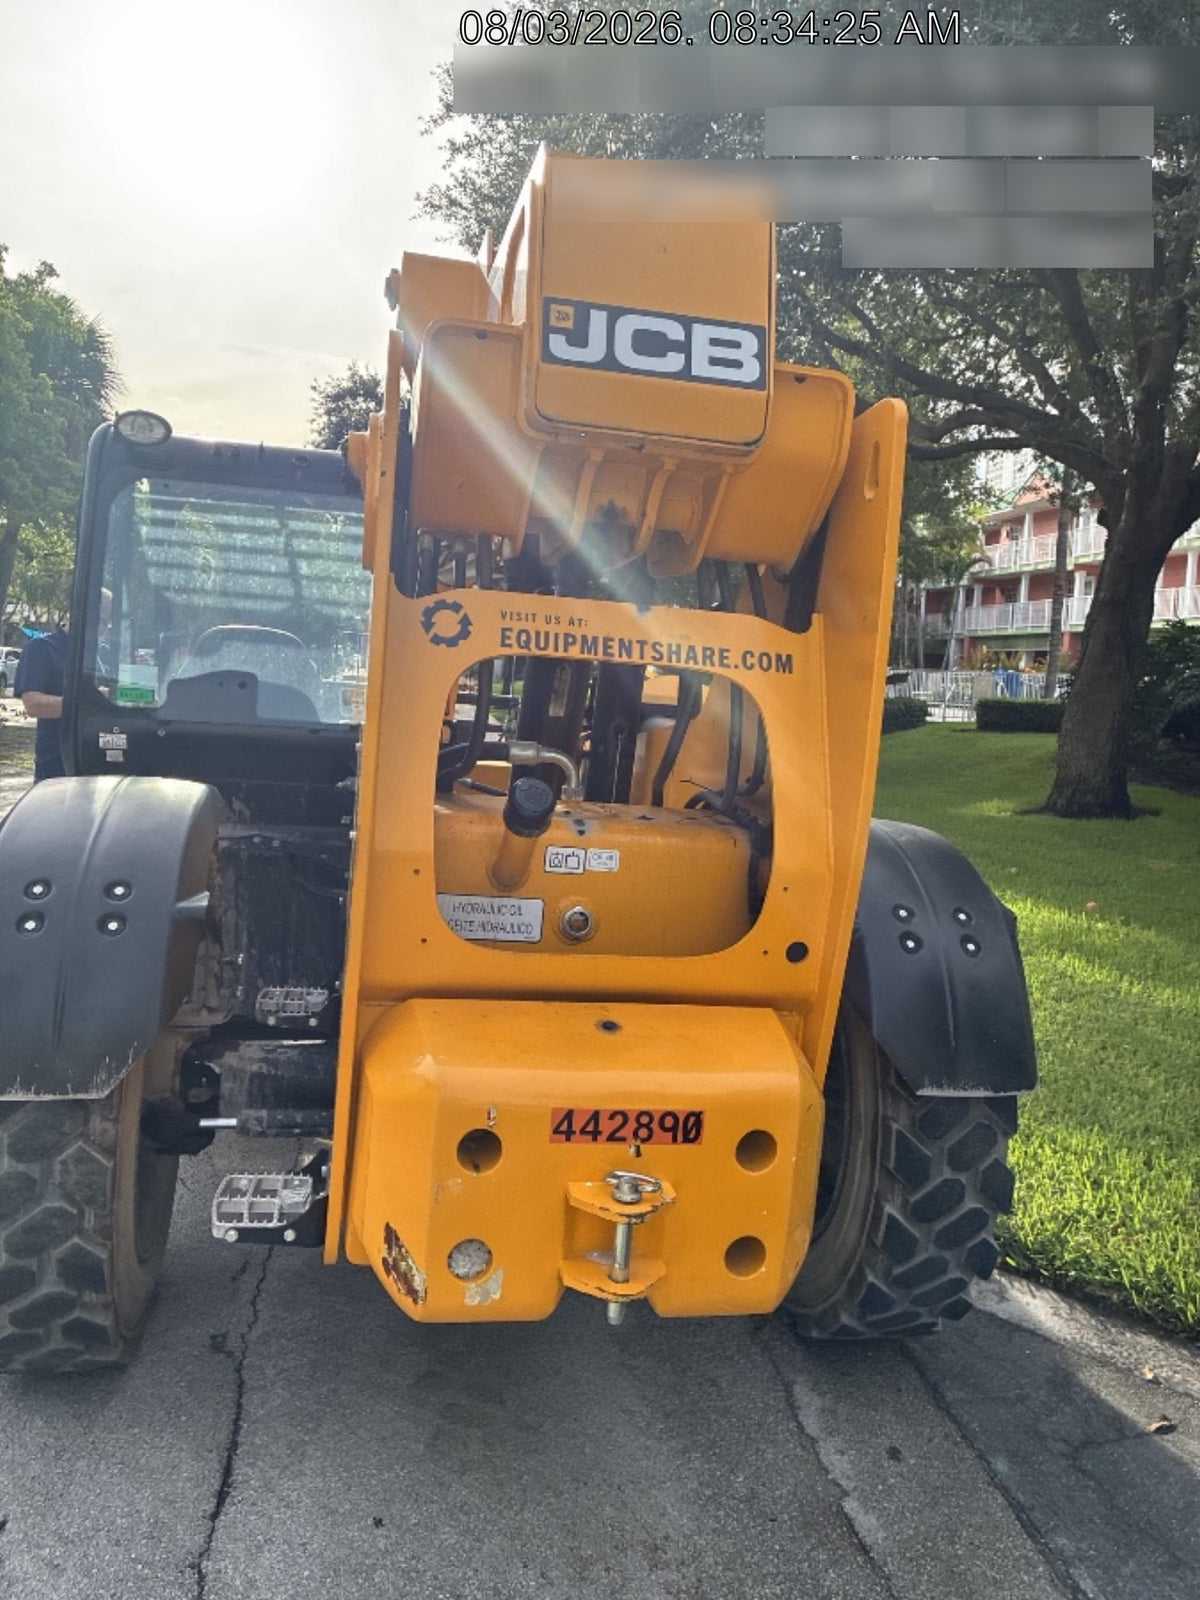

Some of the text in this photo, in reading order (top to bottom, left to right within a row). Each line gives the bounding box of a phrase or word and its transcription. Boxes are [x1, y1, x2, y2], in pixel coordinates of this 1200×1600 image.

[549, 308, 761, 383] JCB
[501, 609, 589, 628] VISIT US AT:
[500, 626, 794, 675] EQUIPMENTSHARE.COM
[552, 1108, 704, 1144] 442890
